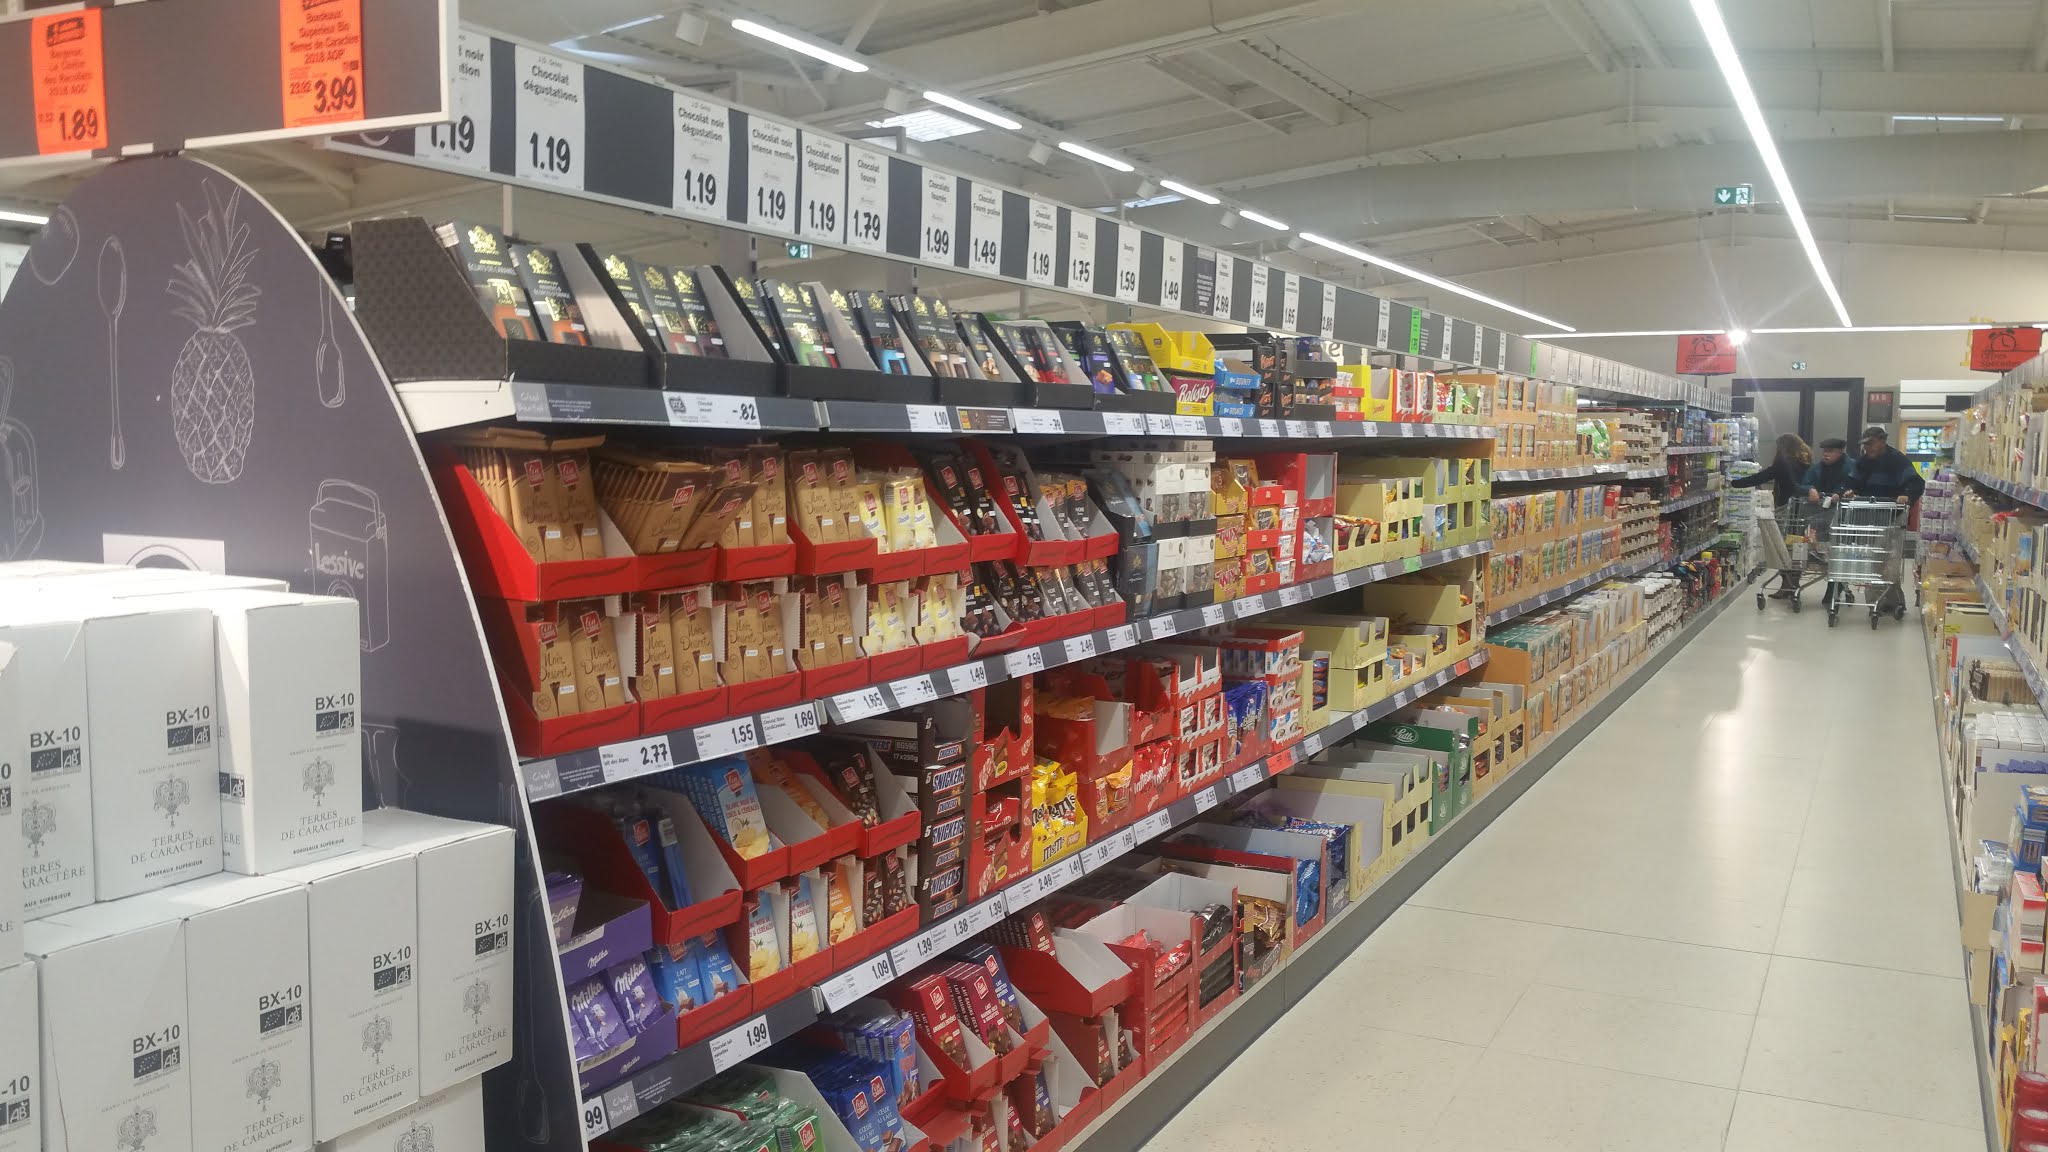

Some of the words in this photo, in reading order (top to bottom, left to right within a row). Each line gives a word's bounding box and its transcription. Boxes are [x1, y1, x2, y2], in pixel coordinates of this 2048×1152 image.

[465, 47, 485, 62] noir
[531, 65, 570, 86] Chocolat
[314, 76, 357, 113] 3.99
[523, 79, 578, 103] dégustations
[59, 108, 98, 141] 1.89
[678, 107, 709, 126] Chocolat
[710, 118, 725, 129] noir
[752, 128, 781, 147] Chocolat
[781, 138, 793, 149] noir
[529, 132, 571, 174] 1.19
[805, 145, 829, 162] Chocolat
[829, 152, 843, 164] noir
[857, 159, 880, 174] Chocolat
[684, 169, 717, 206] 1.19
[757, 186, 786, 221] 1.19
[809, 200, 835, 233] 1.19
[853, 210, 881, 241] 1.79
[926, 226, 949, 256] 1.99
[974, 237, 997, 266] 1.49
[1033, 251, 1050, 277] 1.19
[1072, 258, 1091, 284] 1.75
[1119, 270, 1136, 293] 1.59
[1164, 279, 1180, 301] 1.49
[1179, 383, 1210, 403] Balisto
[314, 543, 364, 580] Lessive
[1027, 652, 1042, 667] 2.59
[969, 666, 985, 683] 1.49
[316, 692, 354, 711] BX-10
[863, 692, 883, 709] 1.65
[166, 705, 210, 726] BX-10
[794, 710, 814, 729] 1.69
[925, 718, 933, 730] 5
[30, 726, 81, 749] BX-10
[731, 723, 753, 745] 1.55
[640, 743, 668, 766] 2.77
[925, 772, 932, 784] 5
[932, 764, 965, 792] SNICKERS
[281, 829, 296, 842] DE
[298, 816, 357, 838] CARACTÈRE
[300, 810, 337, 826] TERRES
[152, 830, 194, 848] TERRES
[924, 825, 931, 838] 5
[932, 816, 965, 843] SNICKERS
[130, 851, 147, 865] DE
[150, 834, 216, 860] CARACTÈRE
[22, 859, 62, 878] ERRES
[922, 878, 930, 890] 5
[1039, 873, 1053, 891] 2.49
[552, 905, 577, 926] ilka
[989, 901, 1002, 917] 1.39
[474, 914, 508, 936] BX-10
[954, 917, 969, 937] 1.38
[373, 945, 411, 970] BX-10
[917, 937, 932, 956] 1.39
[587, 949, 609, 969] Milka
[872, 959, 889, 979] 1.09
[615, 962, 646, 994] Milka
[259, 984, 302, 1011] BX-10
[572, 981, 604, 1013] Milka
[132, 1024, 180, 1055] BX-10
[444, 1050, 457, 1062] DE
[458, 1028, 508, 1056] CARACTÈRE
[462, 1025, 493, 1045] TERRES
[746, 1023, 767, 1047] 1.99
[342, 1092, 356, 1105] DE
[358, 1067, 414, 1098] CARACTÈRE
[360, 1064, 396, 1086] TERRES
[242, 1113, 306, 1147] CARACTÈRE
[244, 1111, 285, 1136] TERRES
